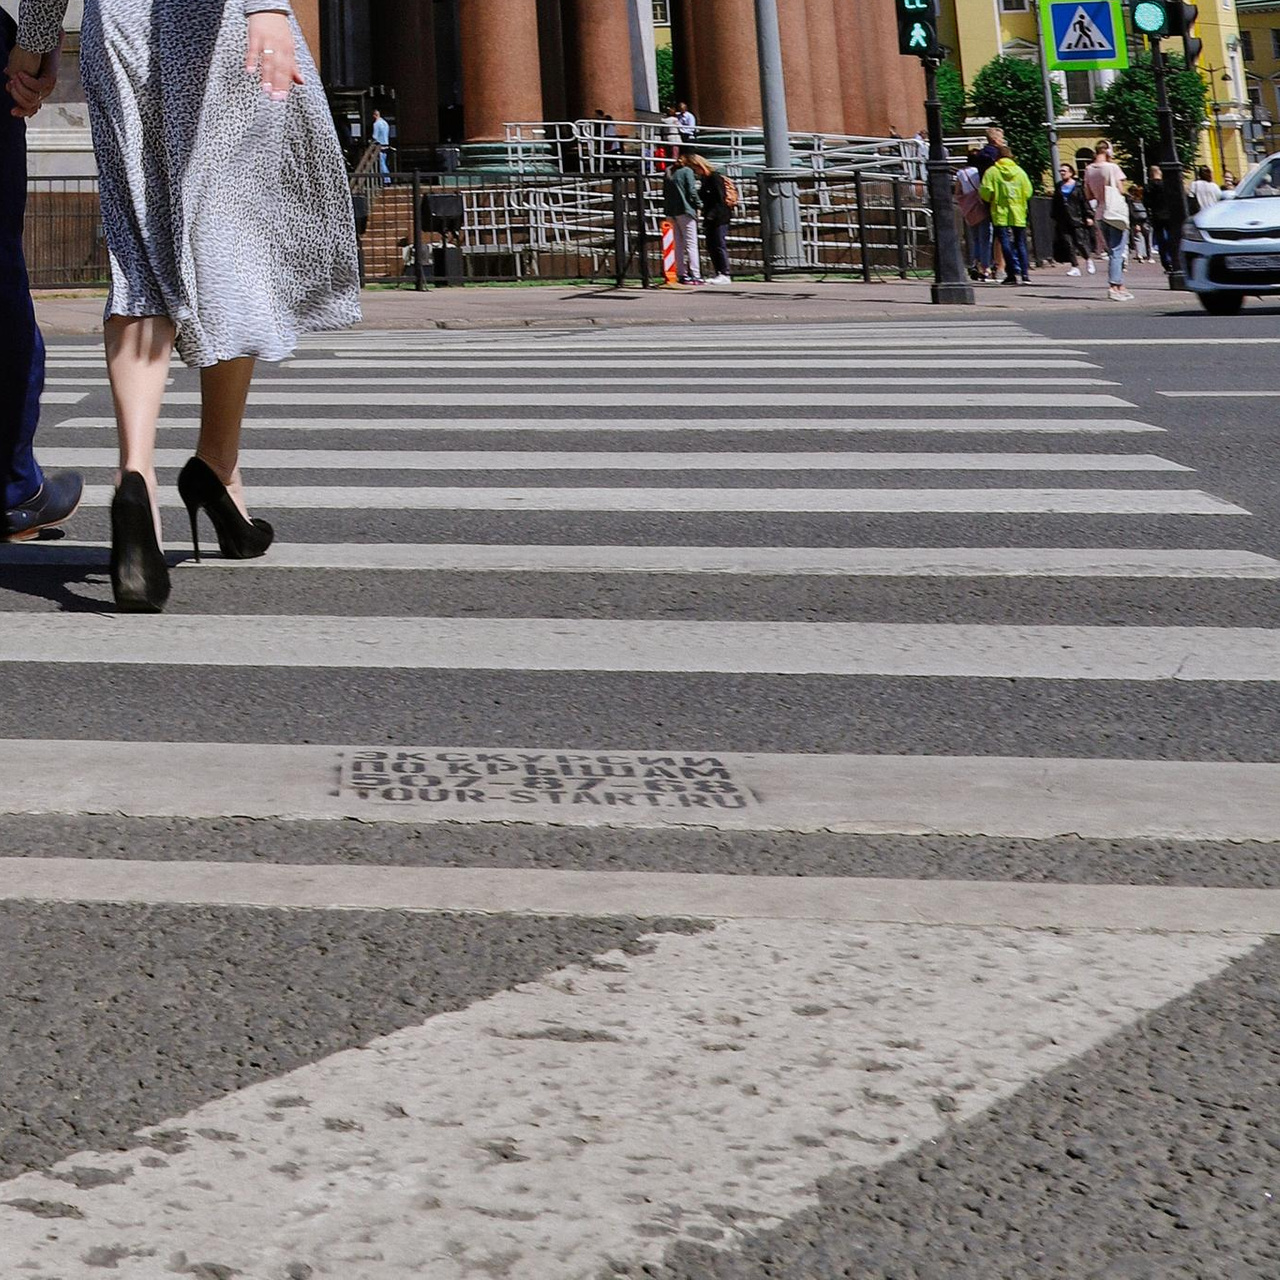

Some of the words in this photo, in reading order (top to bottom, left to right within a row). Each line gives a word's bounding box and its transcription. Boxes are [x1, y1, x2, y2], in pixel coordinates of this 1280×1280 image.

[353, 751, 723, 767] ЭКСКУРСИИ
[352, 760, 426, 774] ПО
[448, 762, 731, 779] КРЫШАМ
[350, 773, 739, 793] 507-87-68
[352, 787, 747, 808] TOUR-START.RU
